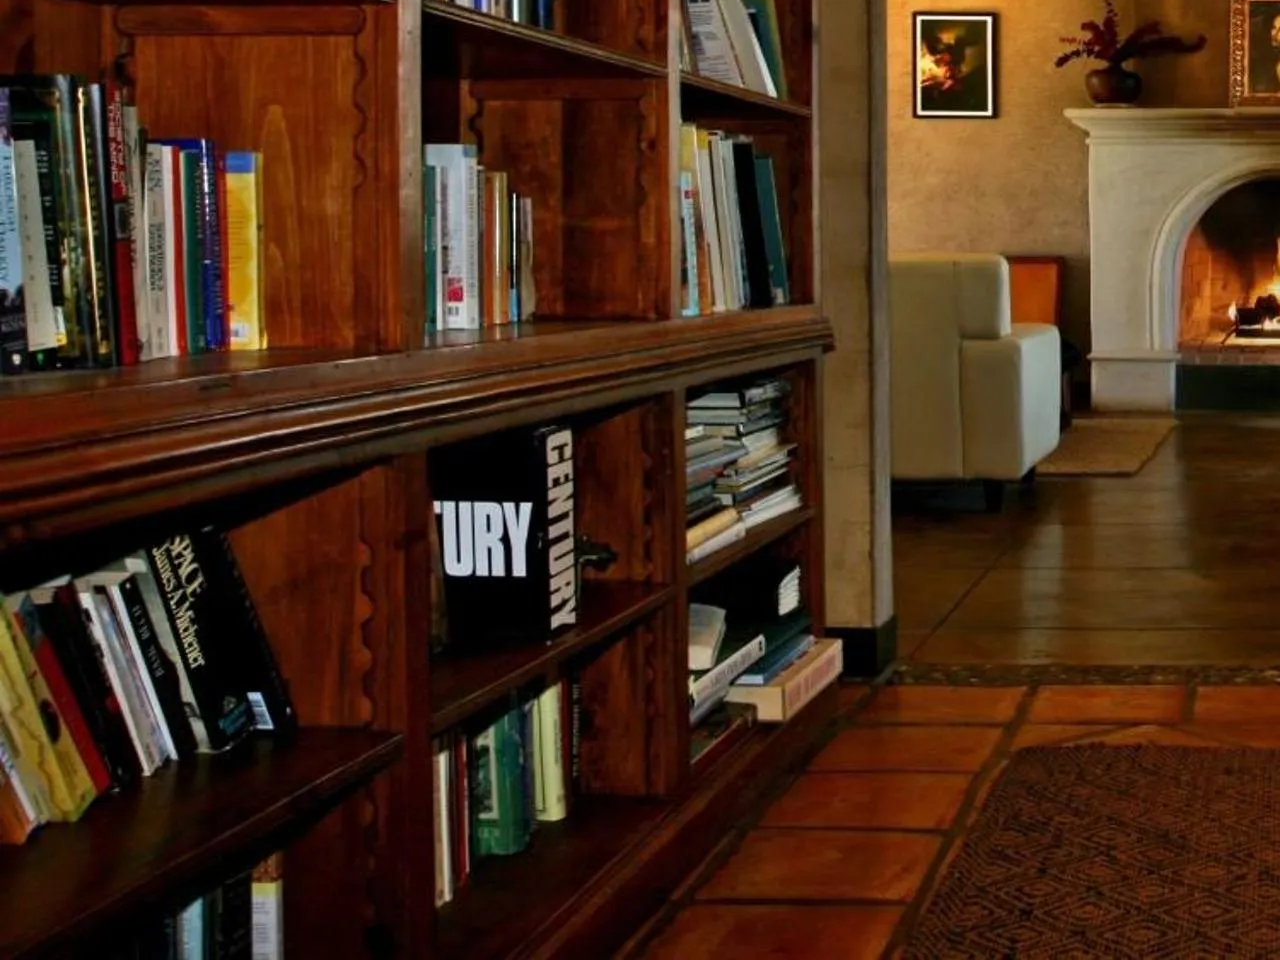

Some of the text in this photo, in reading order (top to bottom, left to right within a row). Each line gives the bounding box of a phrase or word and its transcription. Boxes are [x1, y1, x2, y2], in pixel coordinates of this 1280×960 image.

[169, 535, 206, 602] SPACE
[547, 429, 577, 632] CENTURY
[152, 544, 174, 591] James
[173, 604, 206, 669] Michener
